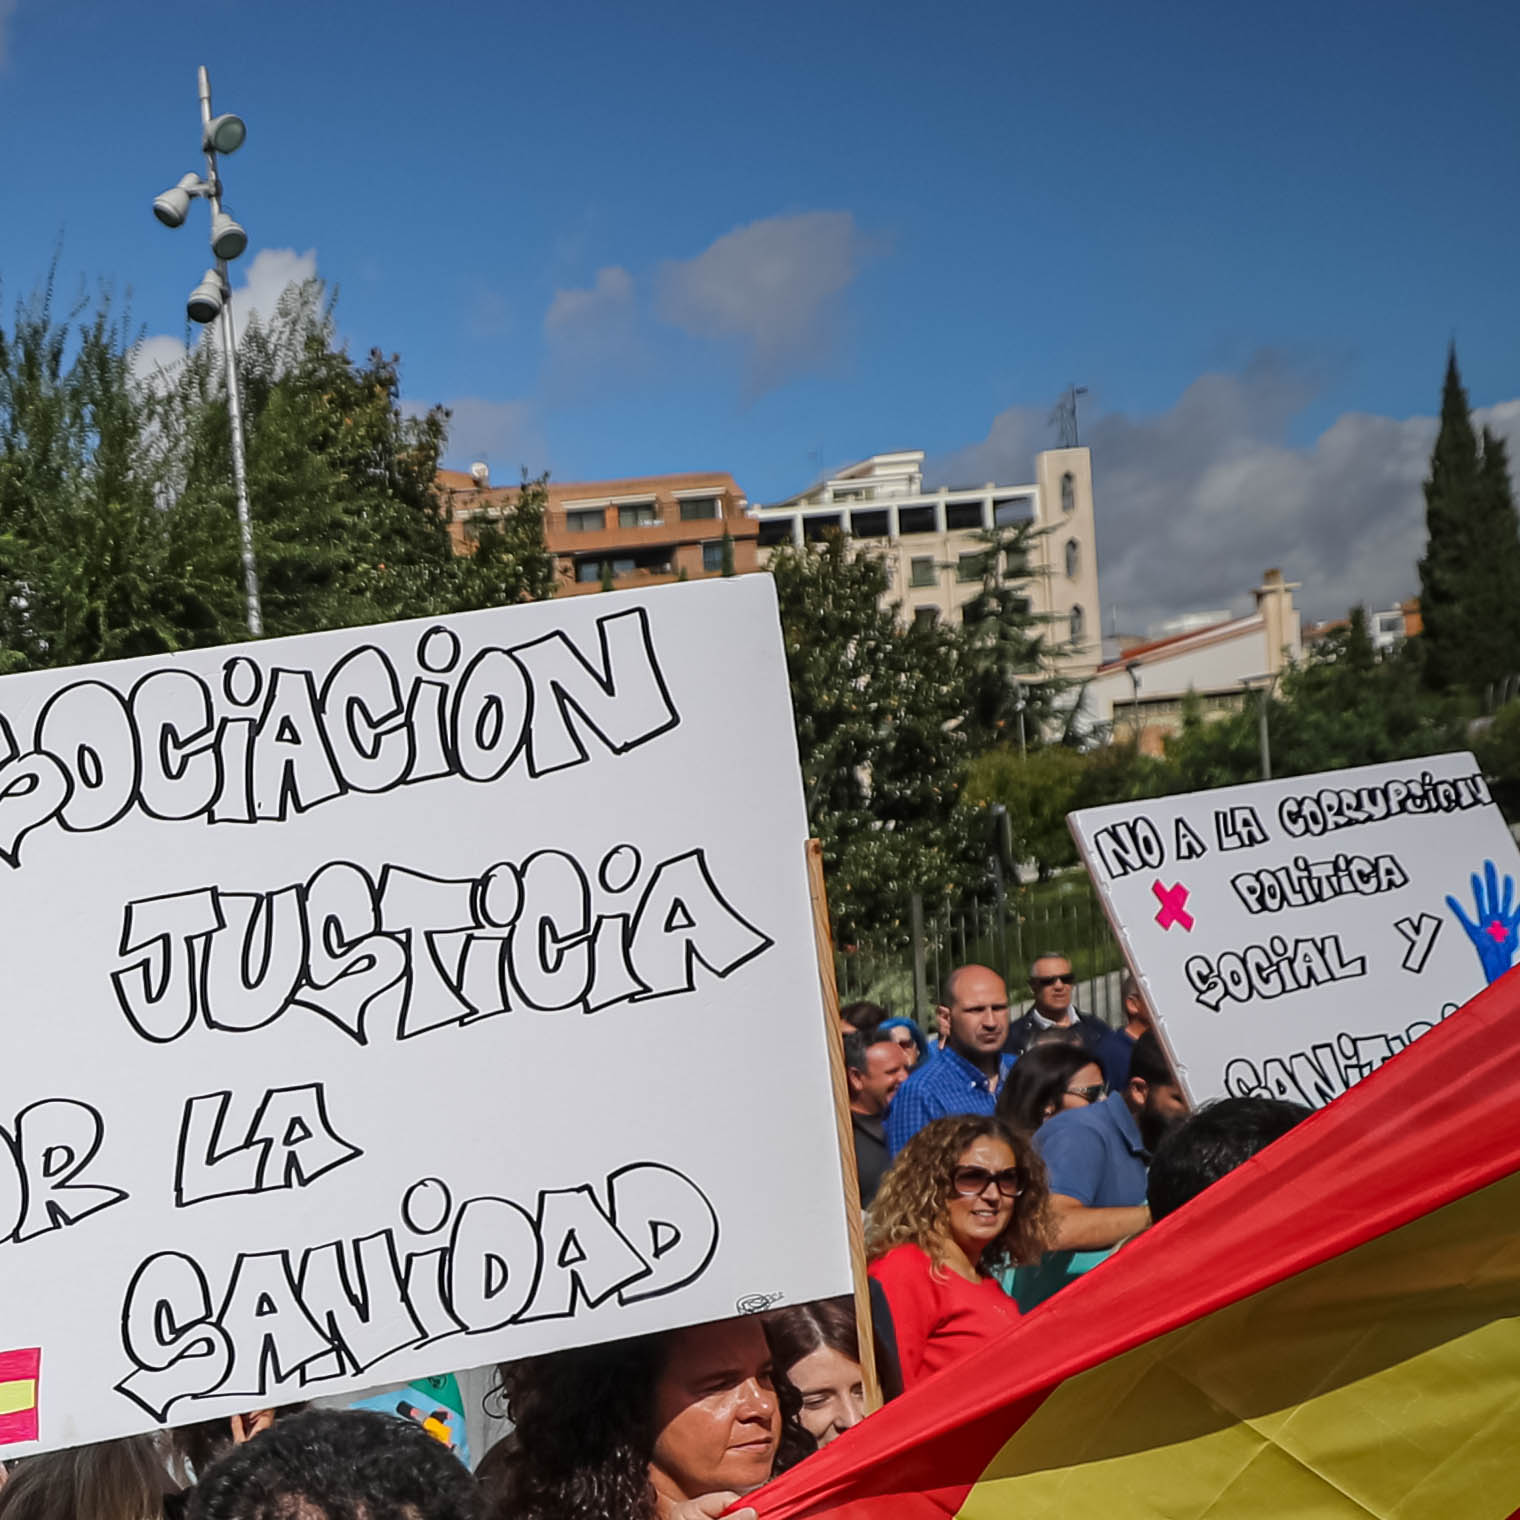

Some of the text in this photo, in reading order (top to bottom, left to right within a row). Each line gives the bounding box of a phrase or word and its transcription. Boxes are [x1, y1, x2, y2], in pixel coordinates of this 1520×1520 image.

[1093, 815, 1165, 880] NO
[1174, 817, 1207, 861] A
[1214, 806, 1270, 852] LA
[110, 843, 775, 1047] JUSTICIA
[1184, 912, 1443, 1013] SOCIAL Y
[173, 1082, 364, 1208] LA
[117, 1178, 720, 1422] SANIDAD
